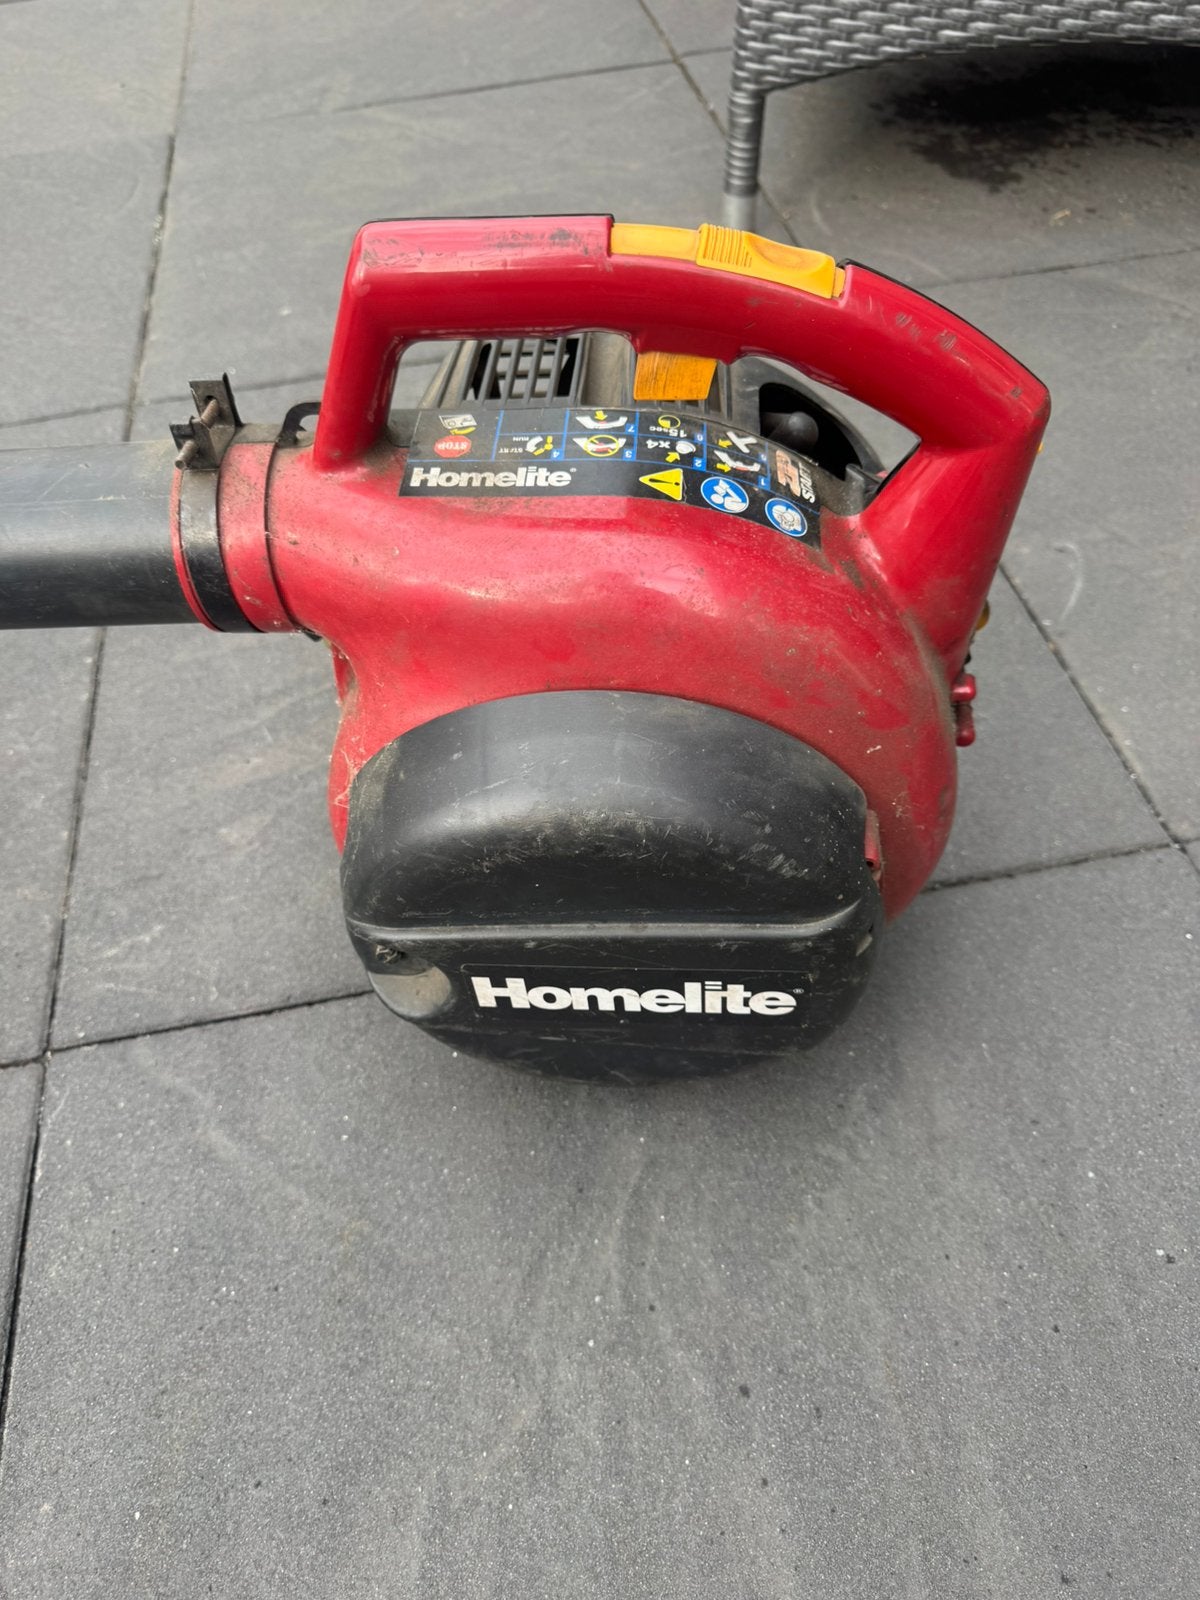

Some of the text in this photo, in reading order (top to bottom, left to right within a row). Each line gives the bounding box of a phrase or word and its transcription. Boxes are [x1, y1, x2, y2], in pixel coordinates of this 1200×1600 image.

[438, 441, 468, 450] STOP
[624, 450, 632, 458] 3
[409, 466, 572, 487] Homelite
[470, 976, 797, 1016] Homelite
